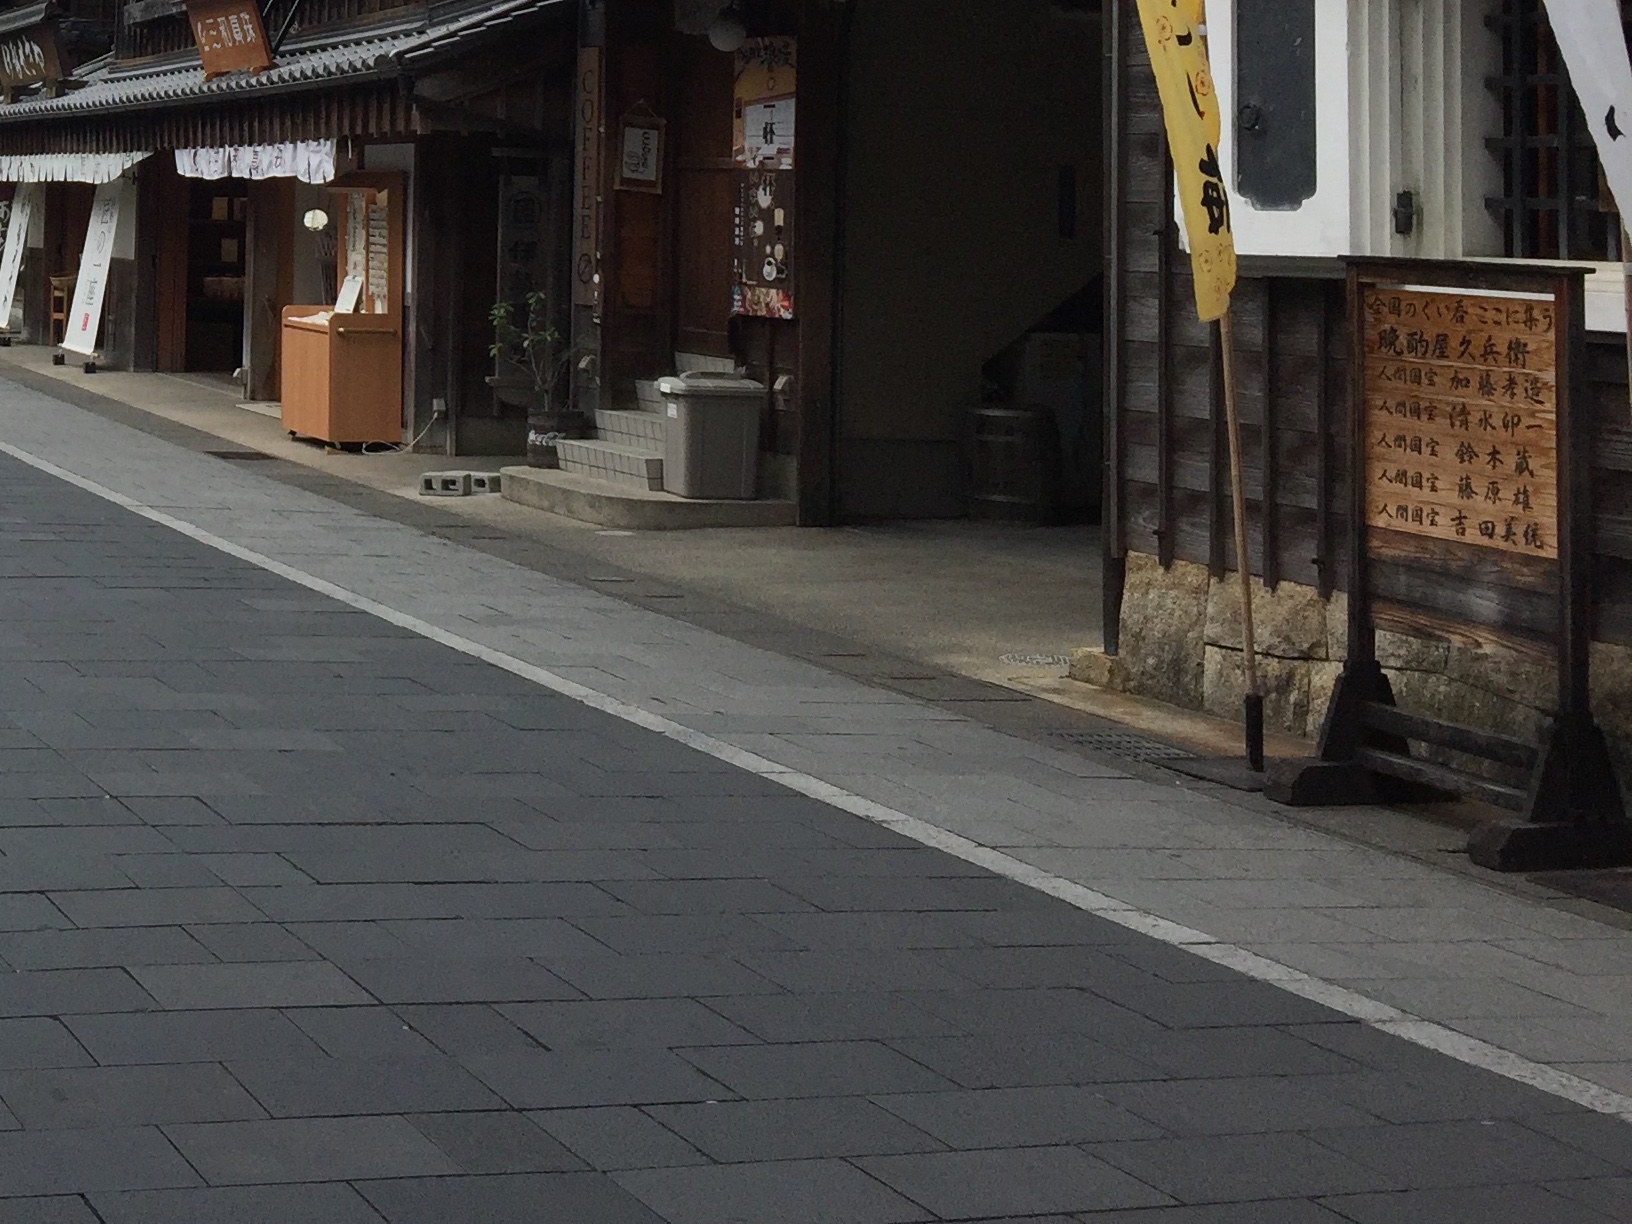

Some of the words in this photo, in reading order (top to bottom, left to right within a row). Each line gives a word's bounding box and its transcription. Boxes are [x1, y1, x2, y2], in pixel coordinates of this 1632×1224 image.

[581, 69, 595, 240] COFFEE
[1478, 303, 1553, 333] ここに集う
[1378, 365, 1438, 387] 人間国宝
[1378, 399, 1438, 421] 人間国宝
[1449, 401, 1544, 438] 清水卯一
[1377, 432, 1440, 458] 人間国宝
[1378, 468, 1440, 493] 人間国宝
[1378, 502, 1440, 528] 人間国宝
